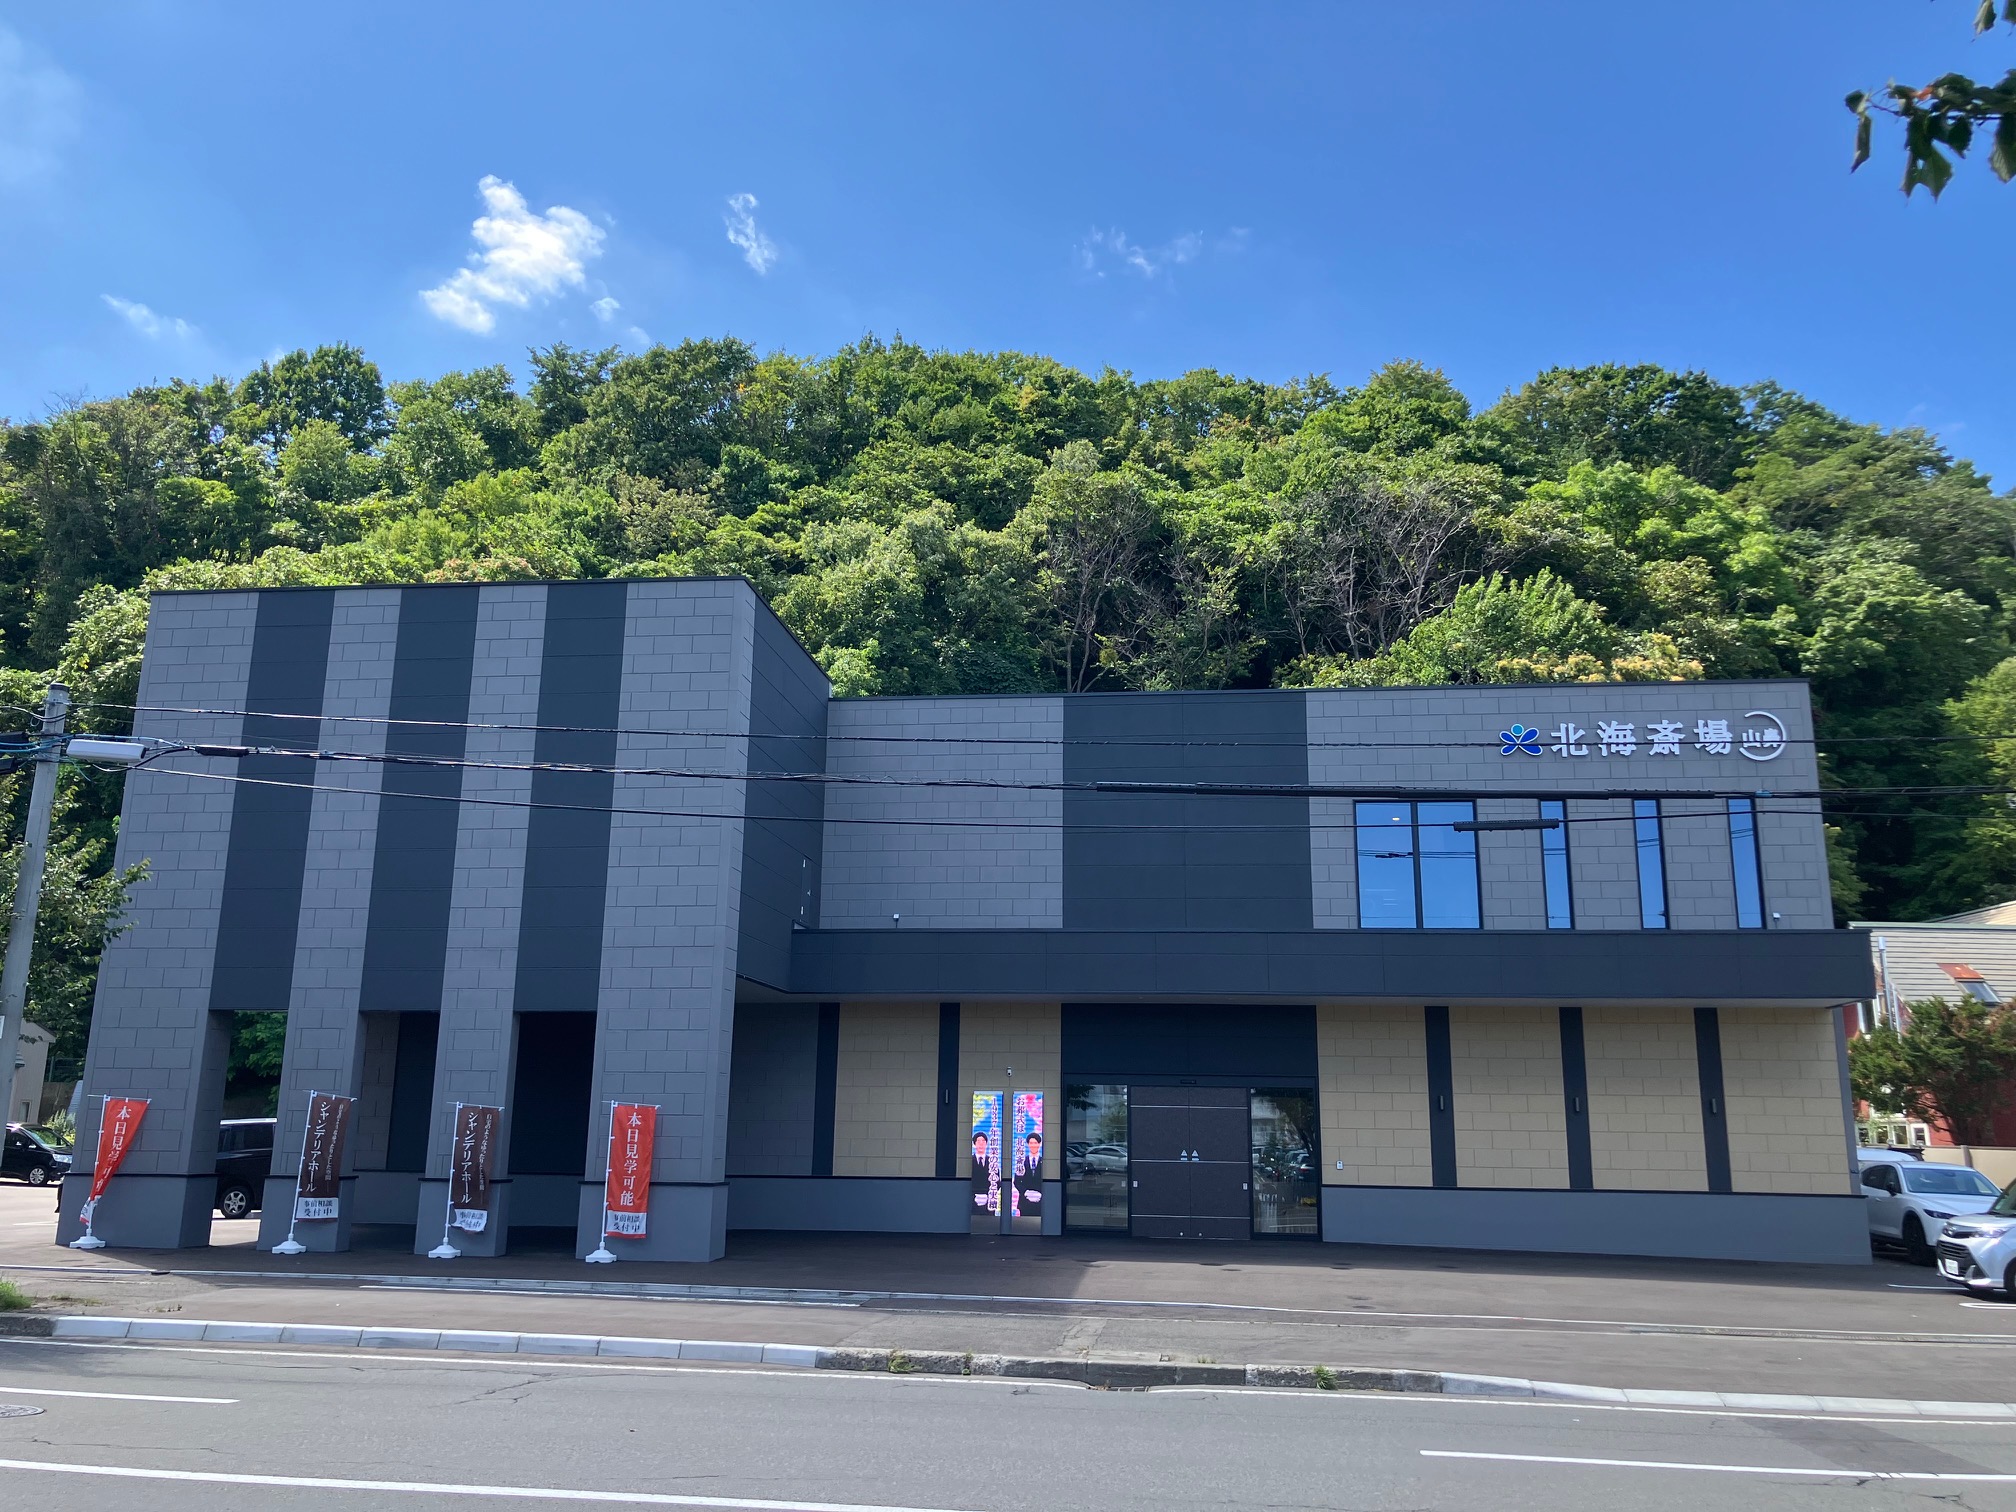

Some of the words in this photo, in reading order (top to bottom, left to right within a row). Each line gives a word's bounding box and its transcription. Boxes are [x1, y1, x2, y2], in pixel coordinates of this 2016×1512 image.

[1550, 719, 1733, 757] 北海斎場
[305, 1101, 331, 1193] シャンテリアホール
[1016, 1097, 1026, 1133] お葬式は
[460, 1111, 479, 1204] シャンテリアホール
[620, 1111, 643, 1207] 本日見学可能
[304, 1207, 332, 1217] 受付中
